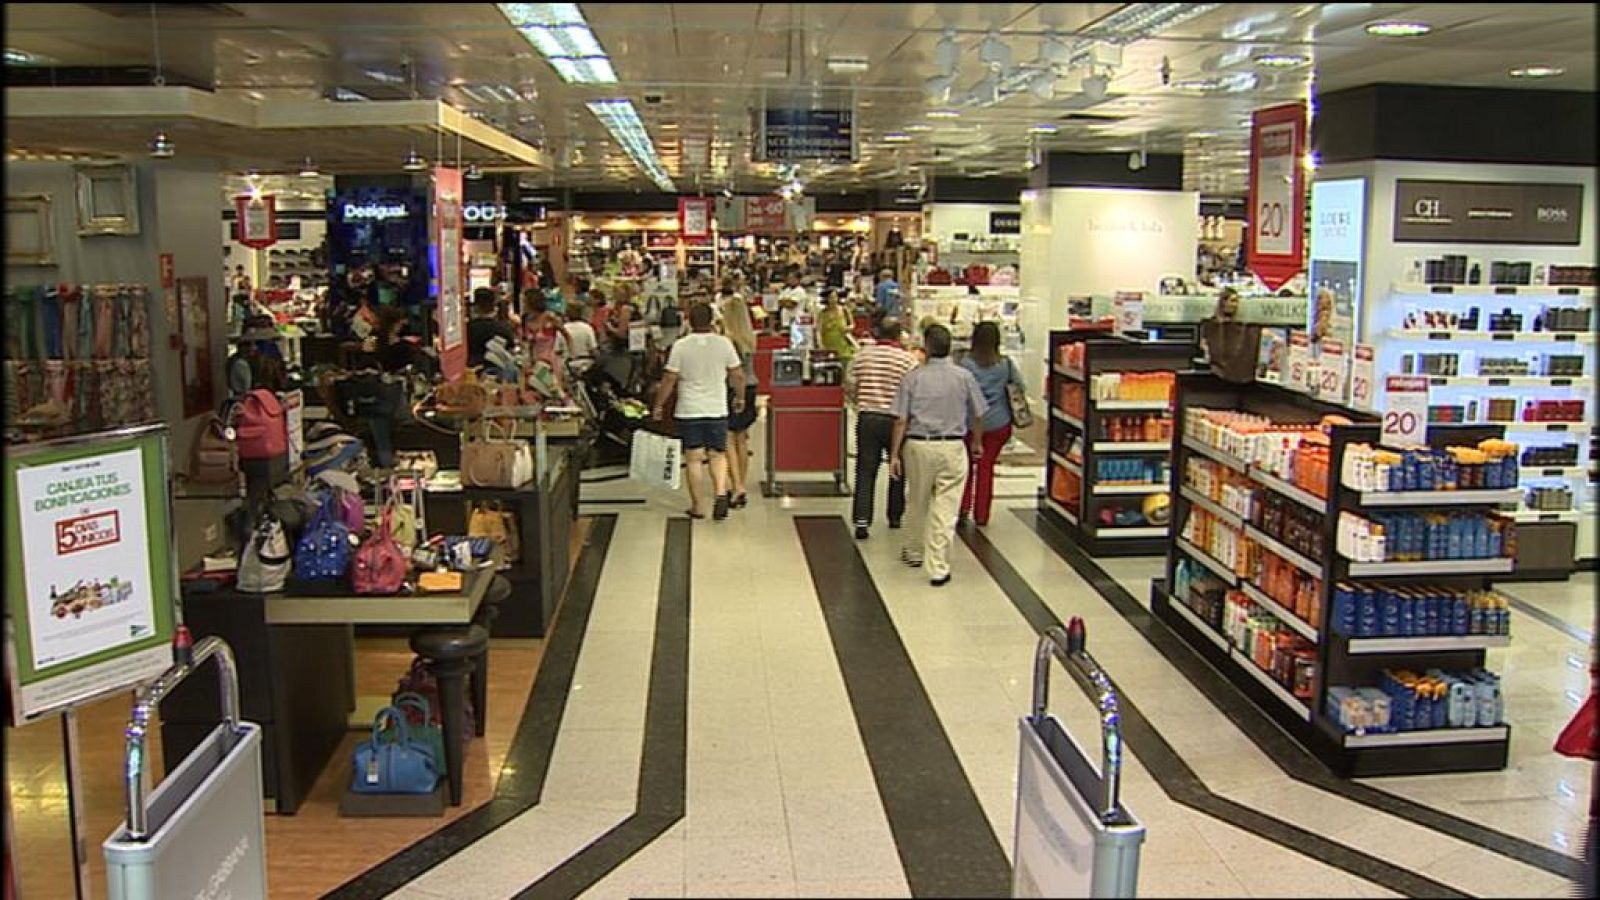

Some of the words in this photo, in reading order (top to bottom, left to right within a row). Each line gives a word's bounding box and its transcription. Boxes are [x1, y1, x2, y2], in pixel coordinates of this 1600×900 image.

[1415, 199, 1440, 216] CH
[1537, 207, 1568, 219] BOSS
[1384, 411, 1416, 435] 20
[95, 471, 119, 485] TUS
[34, 481, 132, 512] BONIFICACIONES
[62, 524, 78, 548] 5
